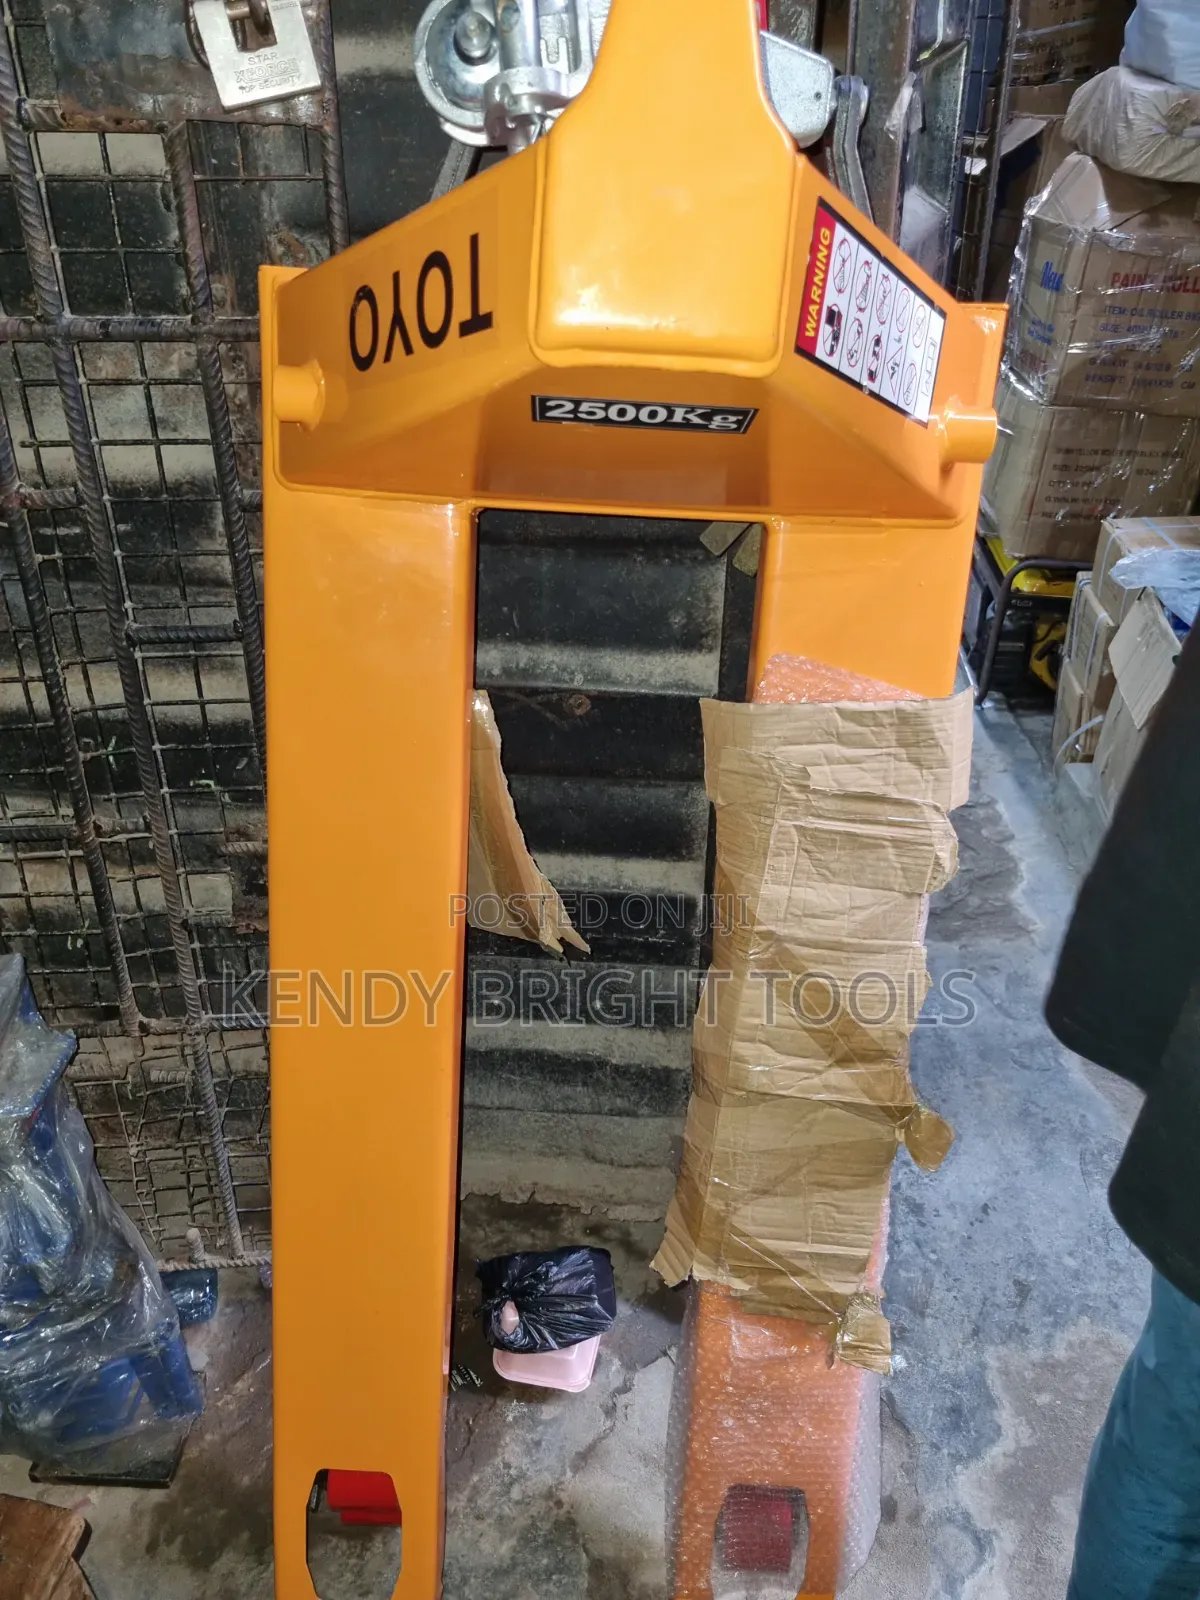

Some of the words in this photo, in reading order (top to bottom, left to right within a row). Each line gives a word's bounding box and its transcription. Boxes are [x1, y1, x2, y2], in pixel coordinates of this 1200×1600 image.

[247, 51, 279, 66] STAR
[259, 74, 302, 91] SECURITY
[804, 226, 832, 339] WARNING
[349, 232, 494, 372] TOYO
[544, 399, 744, 430] 2500Kg
